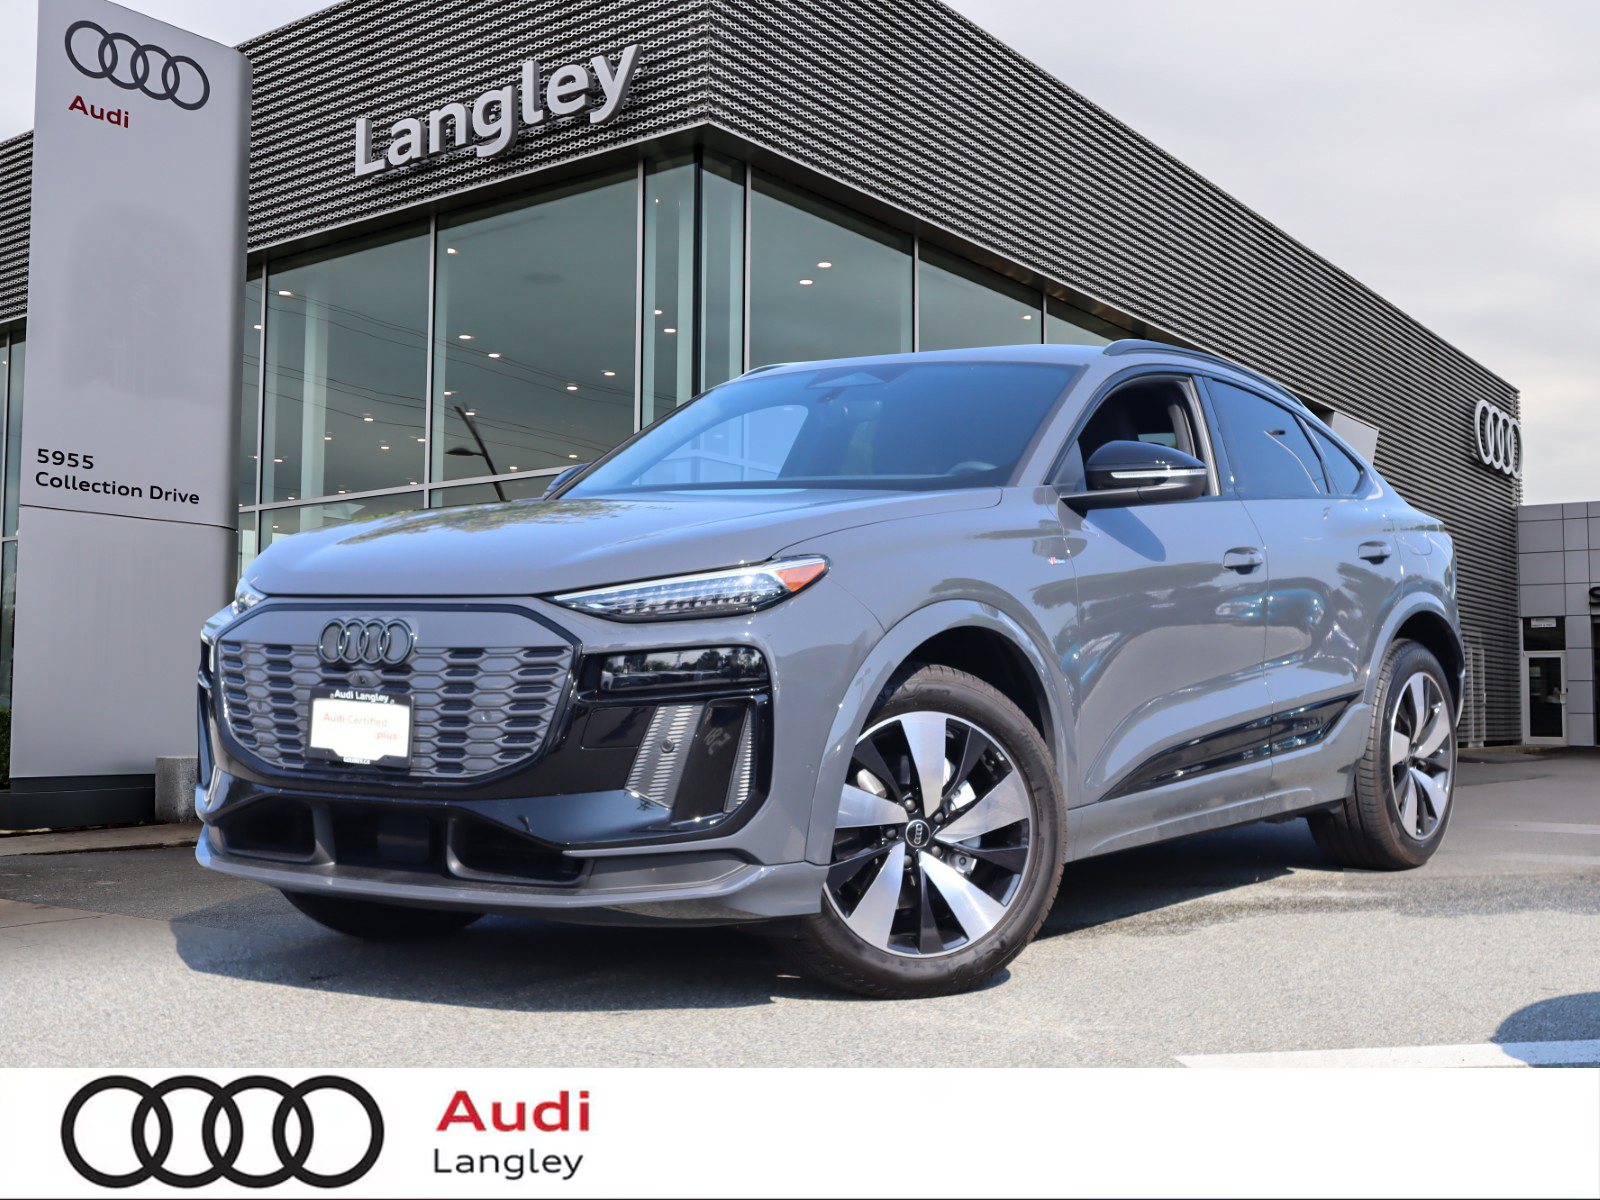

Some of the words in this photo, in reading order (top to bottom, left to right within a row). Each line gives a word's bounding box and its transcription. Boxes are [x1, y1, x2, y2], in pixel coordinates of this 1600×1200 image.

[69, 95, 129, 129] Audi
[354, 44, 643, 177] Langley
[36, 447, 94, 470] 5955
[35, 471, 143, 499] Collection
[149, 484, 200, 505] Drive
[334, 689, 354, 699] Audi
[355, 690, 389, 704] Langley
[323, 712, 345, 723] Audi
[347, 714, 388, 728] Certified
